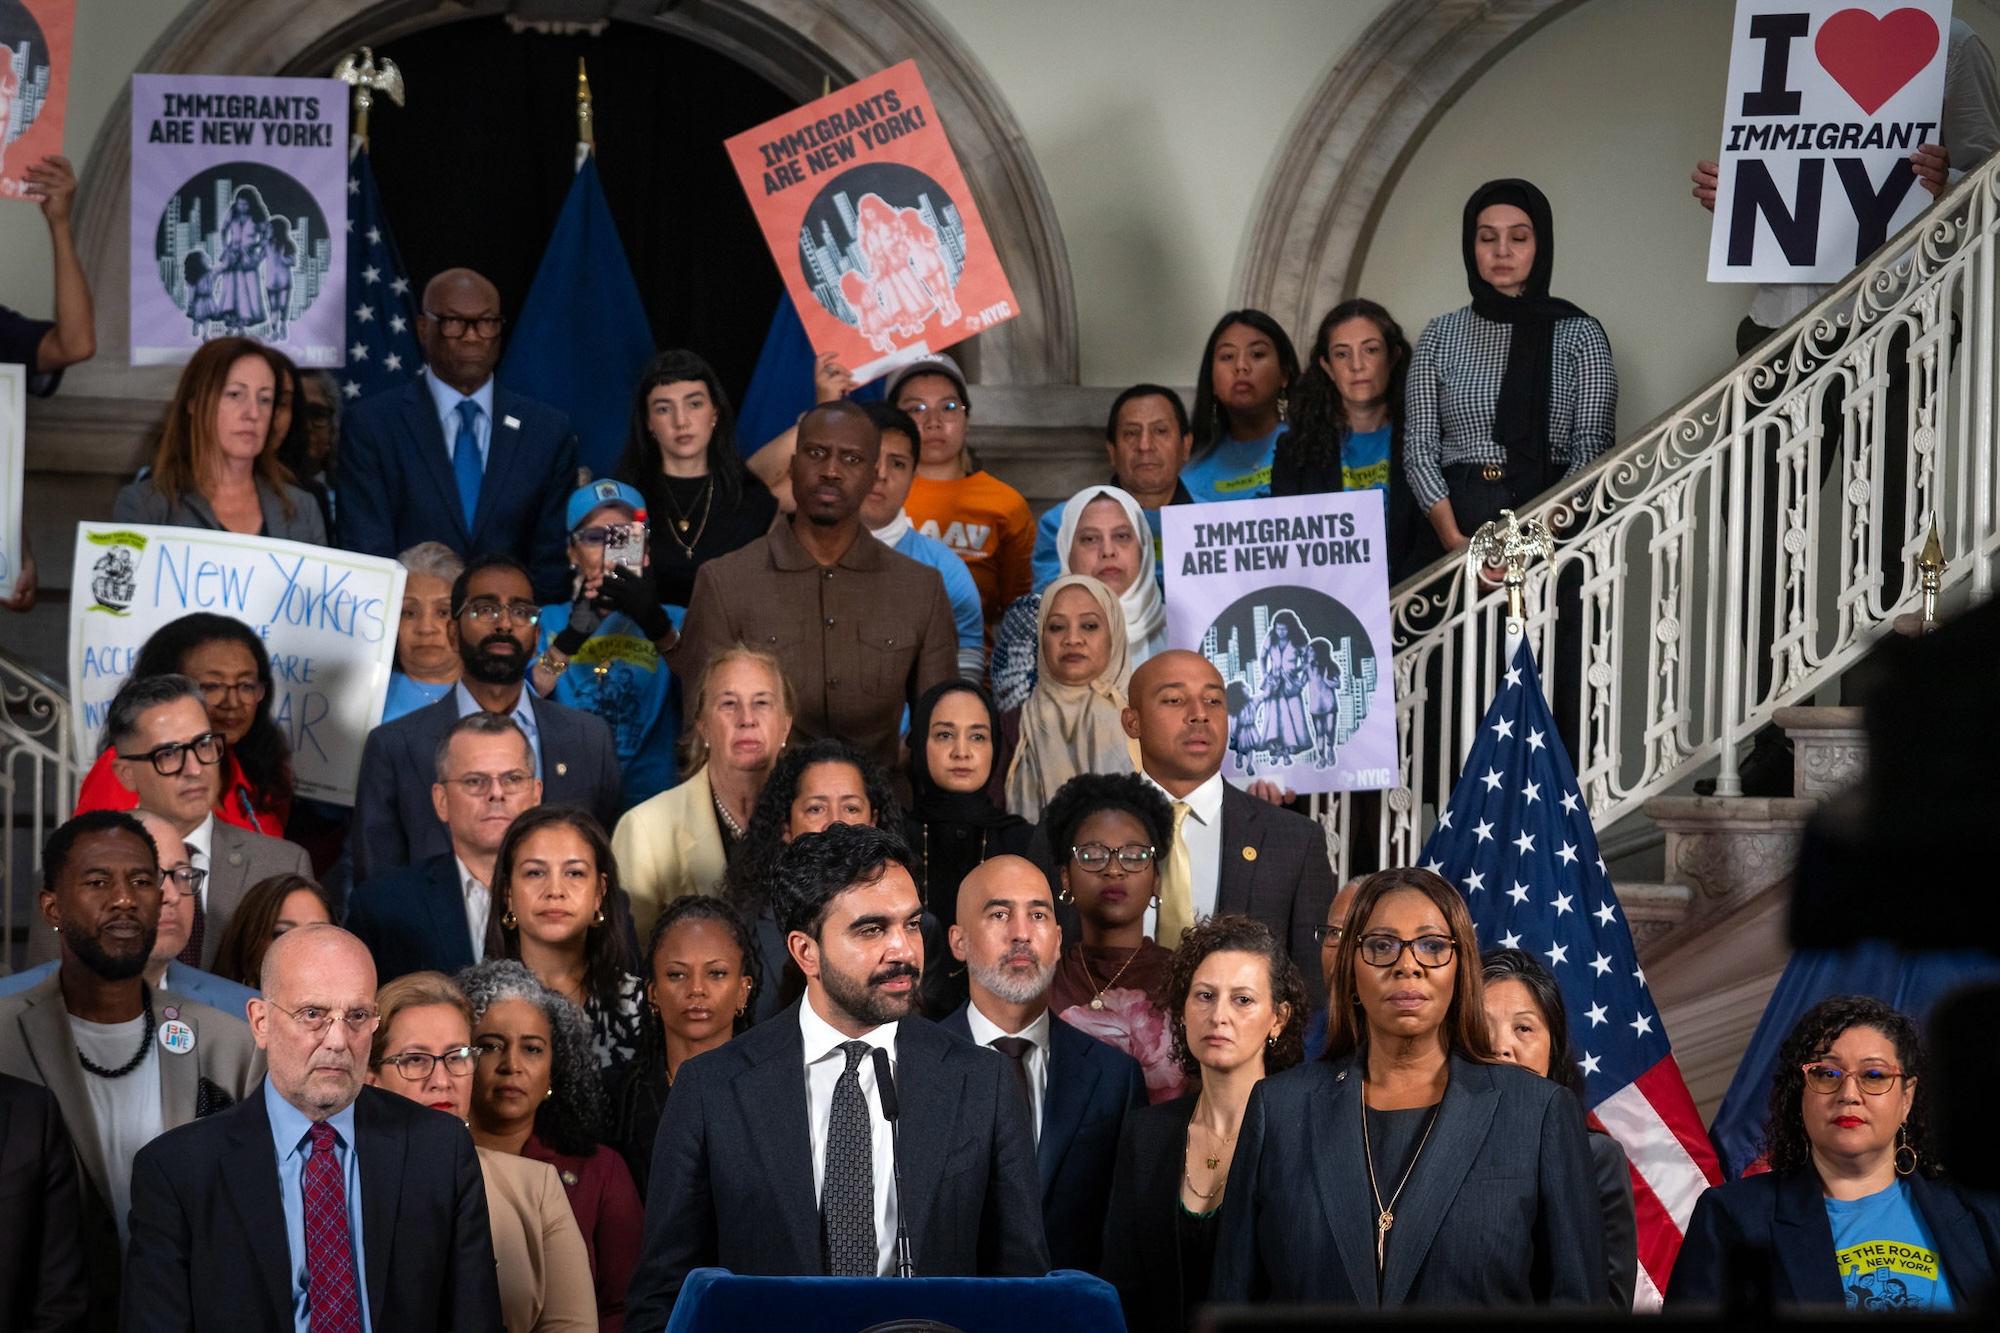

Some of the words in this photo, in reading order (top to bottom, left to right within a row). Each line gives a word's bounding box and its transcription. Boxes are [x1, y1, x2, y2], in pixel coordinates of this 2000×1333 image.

[1742, 13, 1810, 117] I
[163, 93, 320, 121] IMMIGRANTS
[149, 119, 195, 144] ARE
[201, 120, 256, 145] NEW
[262, 122, 333, 147] YORK!
[759, 89, 902, 168] IMMIGRANTS
[1725, 122, 1937, 151] IMMIGRANT
[763, 159, 806, 196] ARE
[806, 135, 857, 175] NEW
[857, 105, 927, 151] YORK!
[1727, 158, 1919, 267] NY
[979, 300, 1011, 327] NYIC
[908, 517, 991, 549] AAV
[1194, 513, 1356, 548] IMMIGRANTS
[1181, 550, 1228, 576] ARE
[1234, 545, 1289, 572] NEW
[1295, 539, 1371, 567] YORK!
[154, 543, 255, 612] New
[83, 645, 141, 679] ACCE
[270, 652, 318, 684] ARE
[275, 691, 330, 763] AR
[1356, 768, 1391, 788] NYIC
[1836, 1253, 1852, 1267] KE
[1853, 1244, 1885, 1259] THE
[1889, 1245, 1935, 1264] ROAD
[1866, 1257, 1896, 1268] NEW
[1899, 1258, 1933, 1274] YORK
